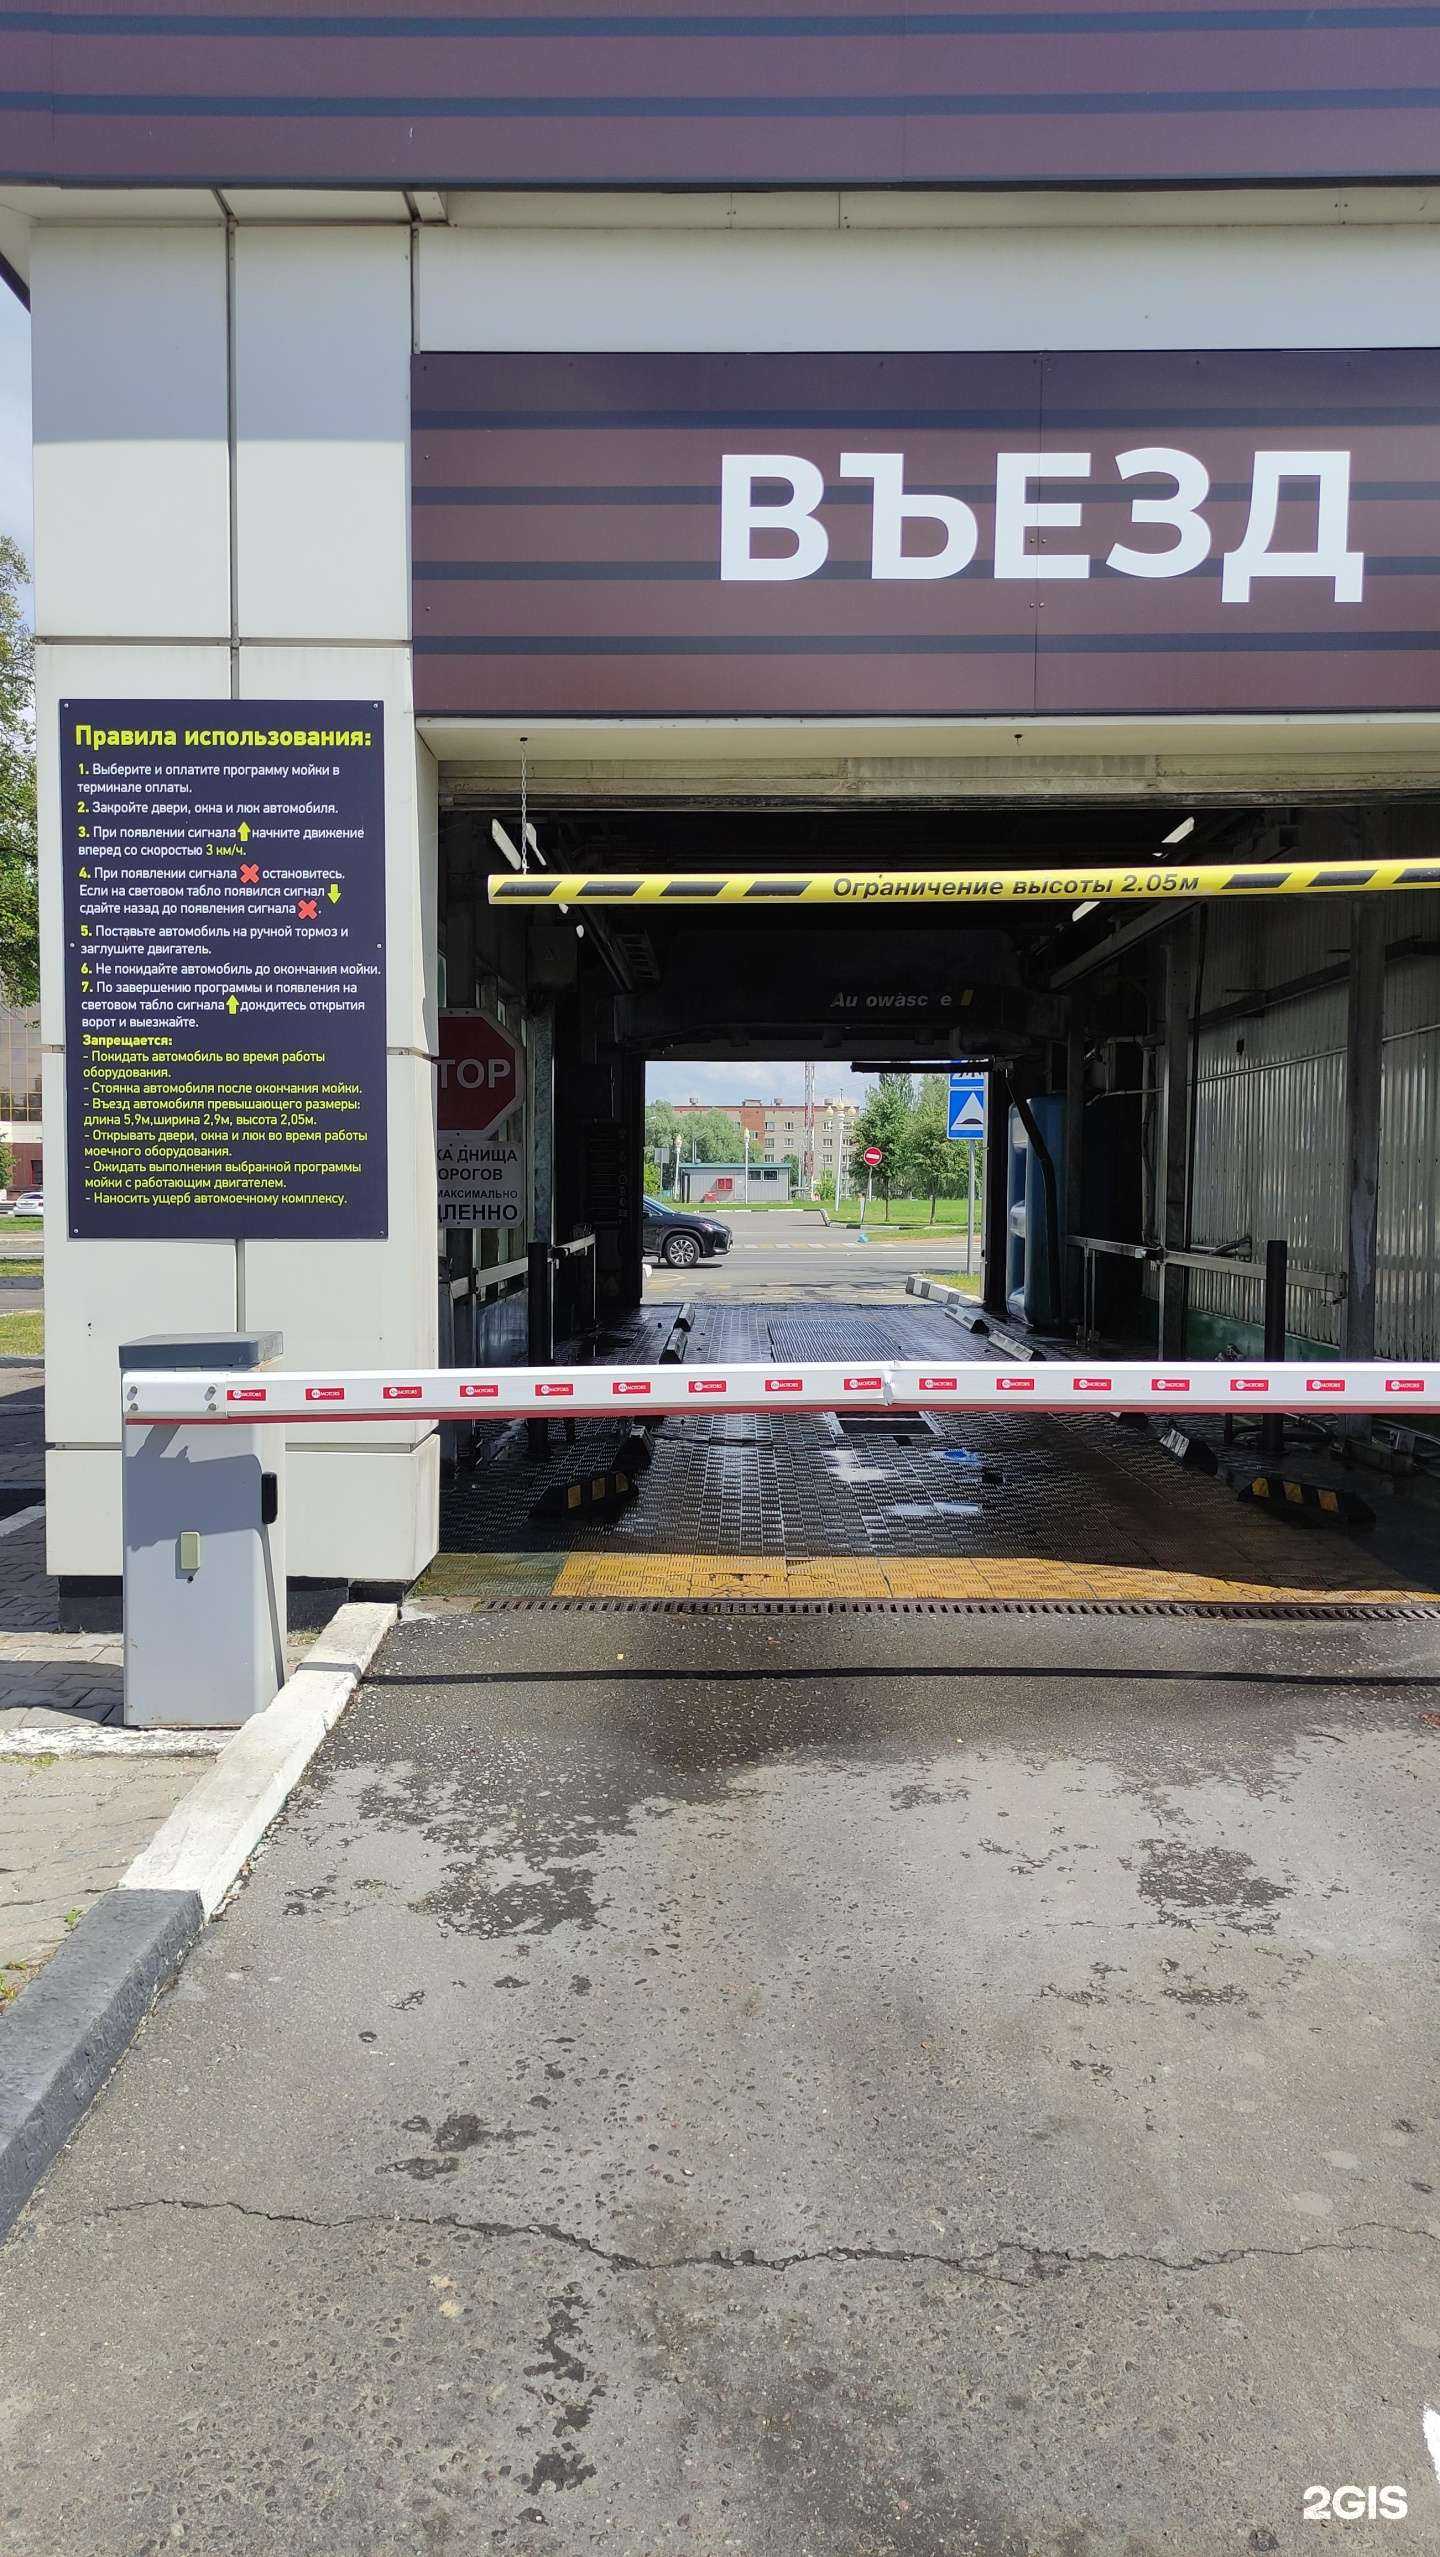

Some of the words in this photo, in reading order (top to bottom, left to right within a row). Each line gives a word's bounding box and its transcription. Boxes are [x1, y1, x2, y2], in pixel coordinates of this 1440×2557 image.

[721, 447, 1364, 603] ВЪЕЗД
[76, 725, 176, 750] Правила
[185, 730, 371, 746] использования:
[79, 763, 89, 775] 1.
[93, 763, 152, 778] Выберите
[155, 766, 162, 775] и
[165, 766, 220, 775] оплатите
[223, 766, 289, 778] программу
[292, 763, 330, 775] мойки
[332, 766, 340, 775] в
[77, 783, 142, 795] терминале
[145, 784, 192, 793] оплаты.
[77, 801, 89, 813] 2.
[92, 801, 149, 816] Закройте
[151, 804, 191, 816] двери,
[194, 804, 223, 813] окна
[226, 804, 233, 813] и
[236, 804, 260, 813] люк
[263, 801, 338, 814] автомобиля.
[78, 826, 90, 838] 3.
[93, 826, 117, 840] При
[120, 829, 185, 838] появлении
[188, 829, 236, 838] сигнала
[252, 829, 300, 838] начните
[303, 827, 364, 840] движение
[78, 846, 122, 858] вперед
[124, 846, 138, 855] со
[140, 846, 203, 858] скоростью
[206, 844, 213, 855] 3
[216, 843, 246, 856] км/ч.
[79, 867, 91, 878] 4.
[94, 867, 118, 881] При
[121, 869, 186, 879] появлении
[189, 869, 237, 879] сигнала
[262, 870, 345, 880] остановитесь.
[80, 884, 108, 896] Если
[111, 887, 126, 896] на
[128, 887, 184, 896] световом
[186, 884, 221, 896] табло
[224, 887, 281, 896] появился
[283, 887, 325, 899] сигнал
[833, 876, 1004, 899] Ограничение
[1012, 876, 1114, 896] высоты
[1121, 873, 1200, 894] 2.05м
[79, 902, 121, 915] сдайте
[123, 904, 160, 915] назад
[161, 904, 177, 915] до
[180, 904, 245, 914] появления
[247, 904, 296, 914] сигнала
[81, 925, 92, 936] 5.
[96, 925, 156, 940] Поставьте
[158, 925, 230, 937] автомобиль
[233, 928, 247, 937] на
[250, 925, 292, 939] ручной
[294, 928, 338, 940] тормоз
[341, 928, 348, 937] и
[81, 945, 145, 957] заглушите
[147, 945, 211, 956] двигатель.
[81, 962, 92, 974] 6.
[96, 962, 112, 974] Не
[115, 962, 178, 976] покидайте
[181, 962, 253, 975] автомобиль
[255, 965, 270, 976] до
[273, 965, 337, 975] окончания
[340, 963, 381, 975] мойки.
[81, 981, 93, 992] 7.
[97, 981, 113, 993] По
[116, 984, 191, 995] завершению
[194, 984, 262, 995] программы
[265, 984, 273, 993] и
[276, 984, 340, 993] появления
[343, 984, 357, 993] на
[81, 1001, 137, 1010] световом
[139, 999, 174, 1010] табло
[177, 1001, 225, 1010] сигнала
[240, 1001, 307, 1012] дождитесь
[309, 1001, 365, 1013] открытия
[82, 1018, 116, 1030] ворот
[119, 1018, 126, 1027] и
[130, 1016, 199, 1027] выезжайте.
[82, 1034, 172, 1048] Запрещается:
[92, 1050, 149, 1063] Покидать
[152, 1050, 223, 1062] автомобиль
[226, 1053, 240, 1062] во
[243, 1053, 279, 1064] время
[282, 1050, 325, 1064] работы
[83, 1066, 171, 1080] оборудования.
[437, 1058, 511, 1089] TOP
[92, 1082, 140, 1093] Стоянка
[143, 1082, 214, 1093] автомобиля
[218, 1085, 252, 1093] после
[255, 1085, 319, 1093] окончания
[322, 1082, 362, 1094] мойки.
[93, 1098, 131, 1111] Въезд
[133, 1097, 204, 1109] автомобиля
[207, 1100, 302, 1111] превышающего
[305, 1100, 360, 1111] размеры:
[83, 1116, 121, 1127] длина
[203, 1114, 233, 1126] 2,9м,
[236, 1116, 277, 1125] высота
[281, 1113, 317, 1126] 2,05м.
[93, 1129, 156, 1143] Открывать
[158, 1132, 197, 1143] двери,
[201, 1132, 229, 1141] окна
[232, 1132, 239, 1141] и
[241, 1132, 266, 1141] люк
[268, 1132, 282, 1141] во
[285, 1132, 321, 1143] время
[325, 1129, 368, 1143] работы
[85, 1148, 141, 1156] моечного
[144, 1145, 232, 1159] оборудования.
[457, 1149, 518, 1164] ДНИЩА
[93, 1161, 146, 1174] Ожидать
[149, 1163, 222, 1172] выполнения
[225, 1160, 291, 1174] выбранной
[294, 1164, 361, 1174] программы
[438, 1168, 503, 1181] ОРОГОВ
[85, 1176, 122, 1188] мойки
[125, 1179, 132, 1188] с
[134, 1176, 211, 1190] работающим
[214, 1179, 286, 1189] двигателем.
[94, 1192, 150, 1203] Наносить
[152, 1192, 191, 1206] ущерб
[194, 1195, 279, 1206] автомоечному
[282, 1195, 347, 1206] комплексу.
[438, 1203, 518, 1223] ЛЕННО
